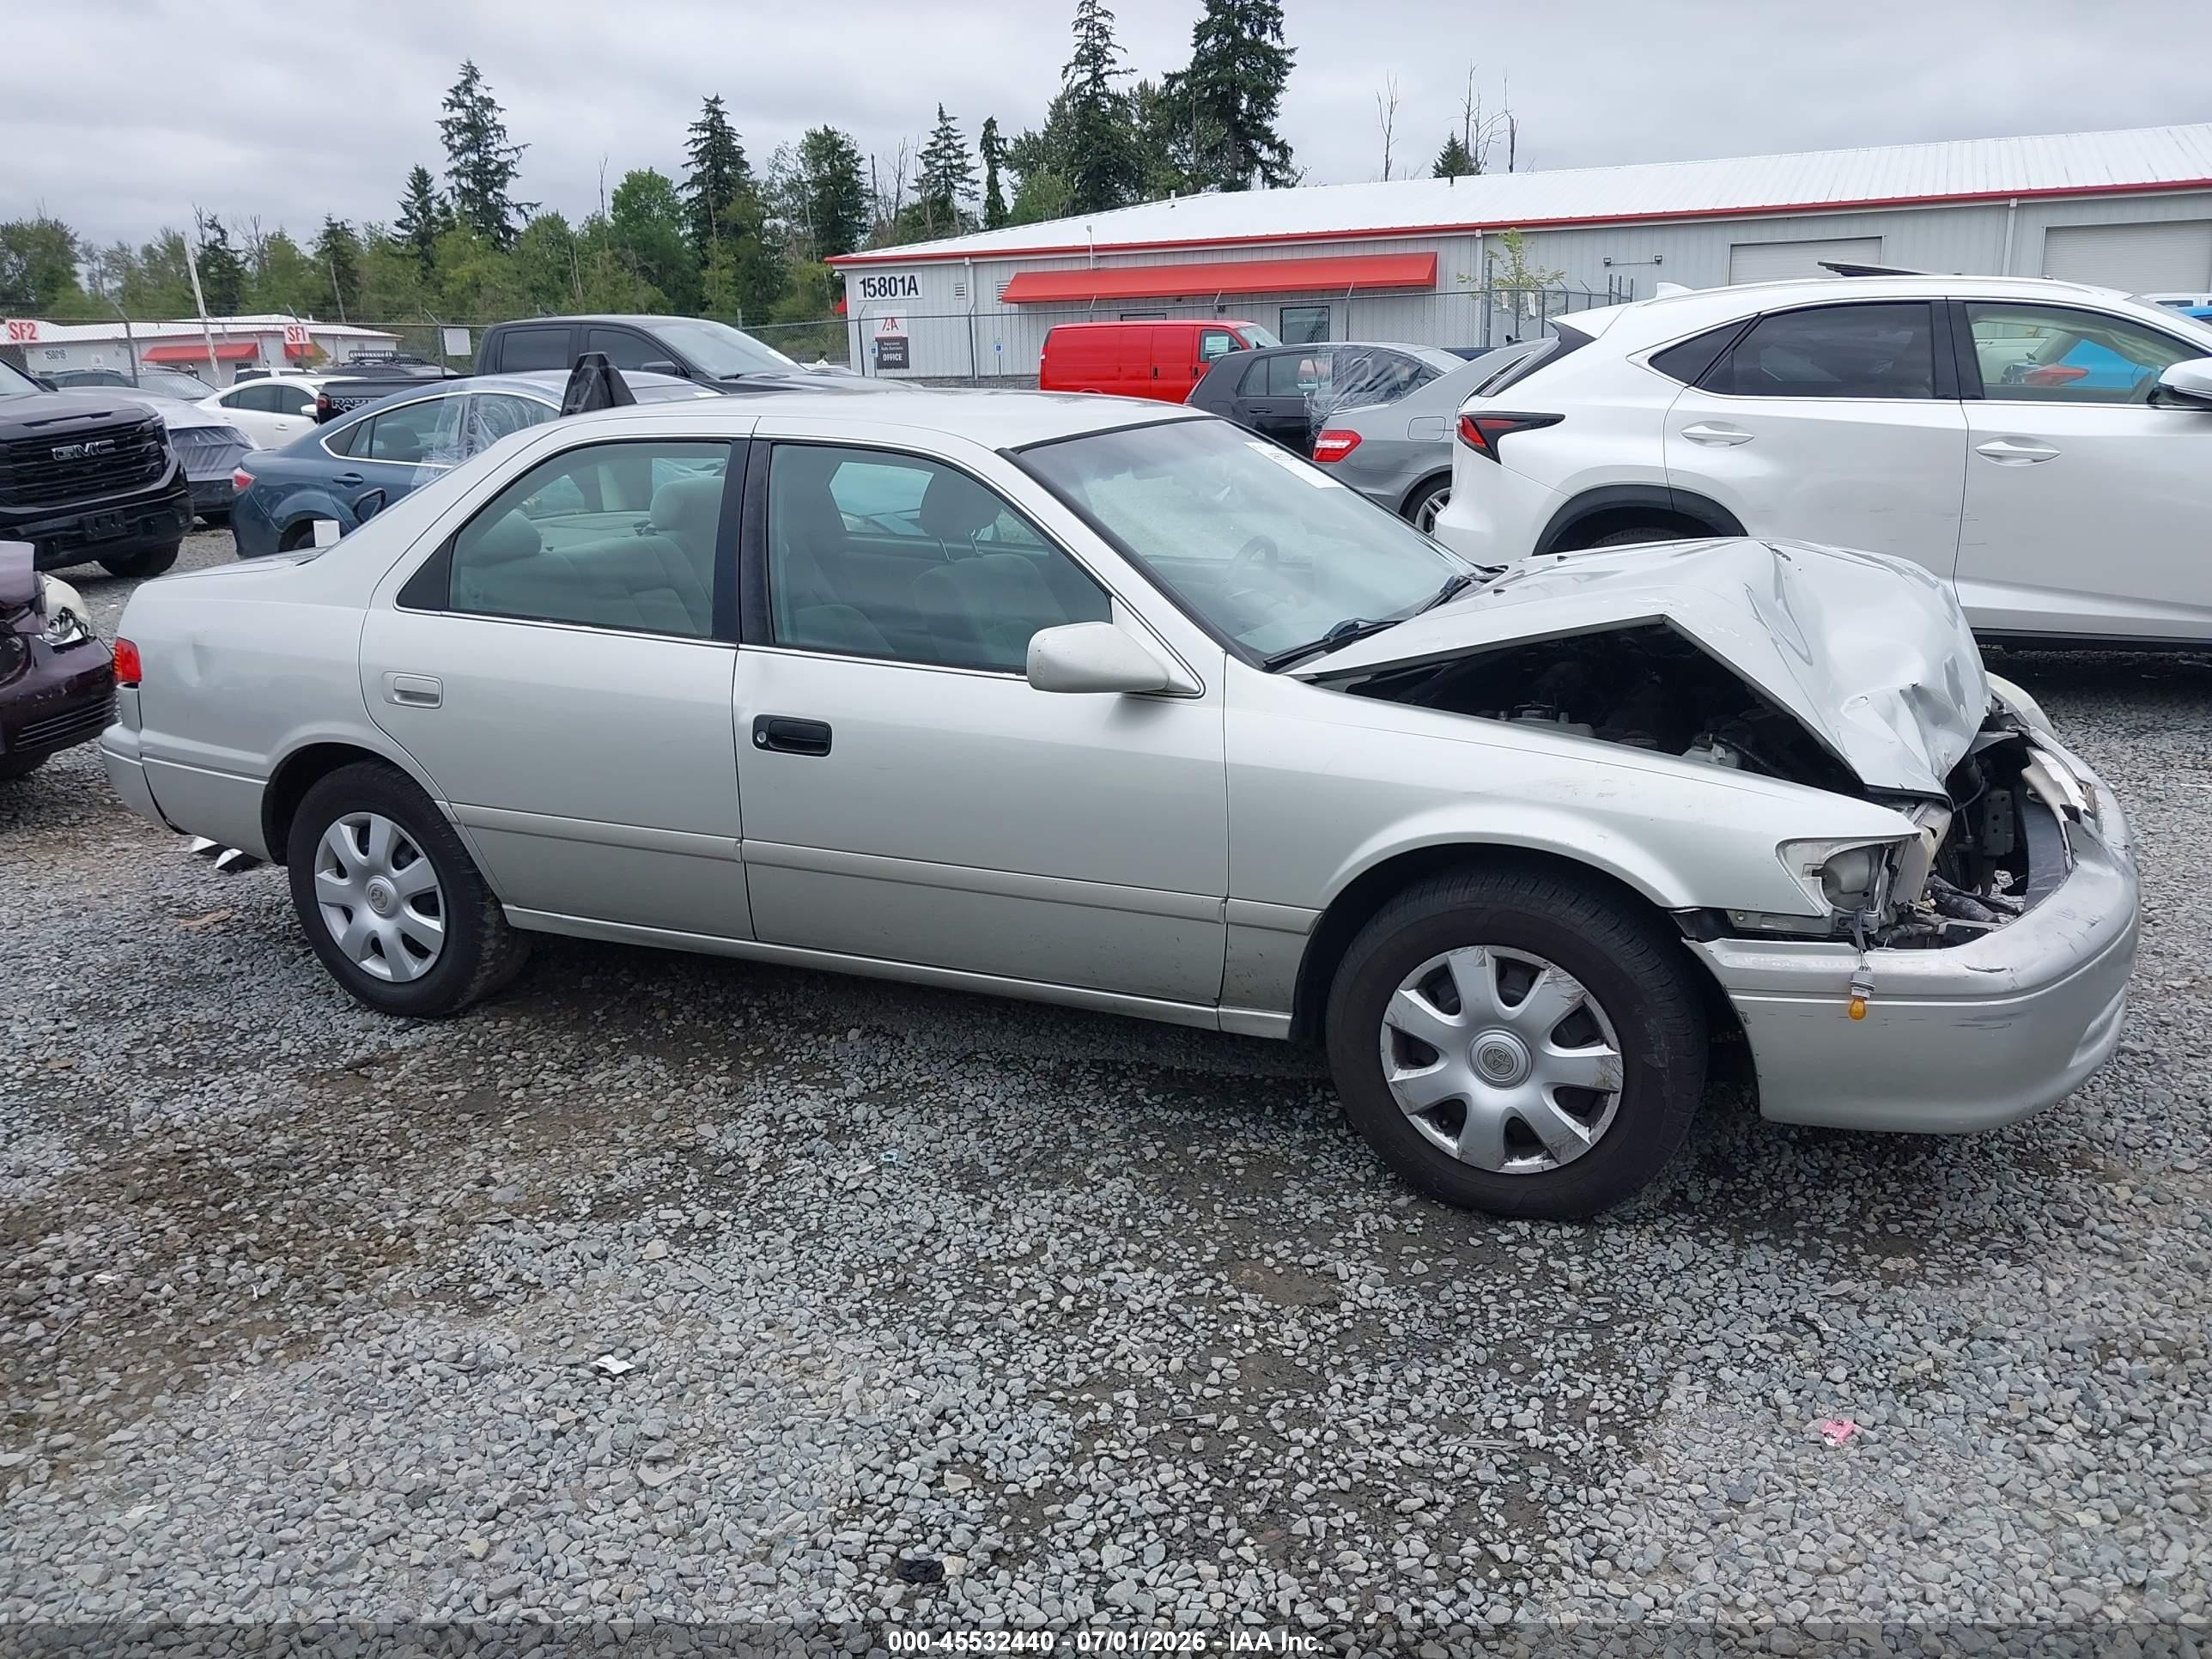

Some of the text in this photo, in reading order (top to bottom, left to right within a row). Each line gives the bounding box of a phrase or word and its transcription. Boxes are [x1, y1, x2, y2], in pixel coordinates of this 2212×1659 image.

[859, 275, 919, 298] 15801A
[9, 322, 37, 340] SF2
[288, 326, 307, 342] SF1
[882, 353, 904, 362] OFFICE
[52, 440, 116, 460] GMC
